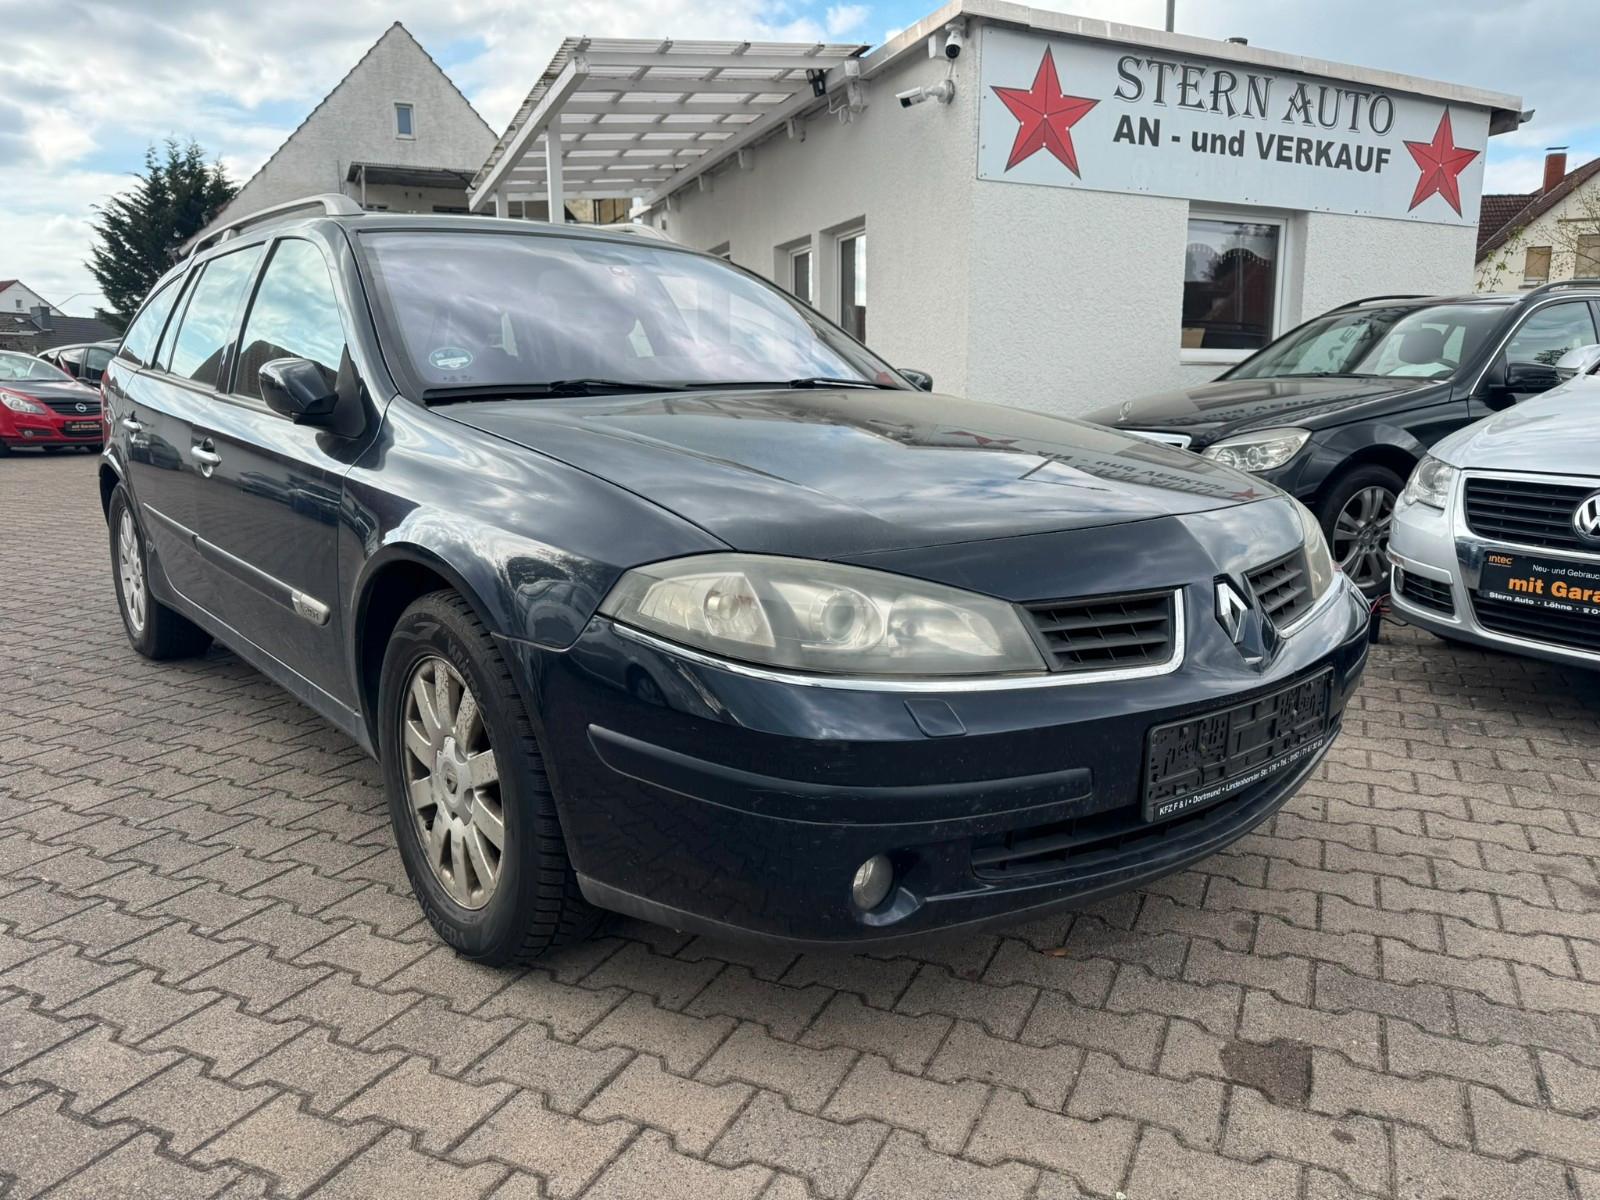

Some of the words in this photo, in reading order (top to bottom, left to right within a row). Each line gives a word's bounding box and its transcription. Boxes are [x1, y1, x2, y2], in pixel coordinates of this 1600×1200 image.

[1113, 54, 1275, 120] STERN
[1282, 81, 1396, 137] AUTO
[1113, 114, 1161, 147] AN
[1190, 130, 1245, 158] und
[1256, 131, 1392, 174] VERKAUF
[1488, 555, 1513, 565] intec
[1532, 564, 1550, 573] Neu-
[1508, 576, 1544, 595] mit
[1488, 591, 1513, 601] Stern
[1514, 596, 1535, 605] Auto
[1544, 600, 1573, 611] Löhne
[1159, 802, 1173, 816] KFZ
[1173, 801, 1179, 811] F
[1178, 800, 1184, 809] &
[1192, 786, 1222, 804] Dortmund
